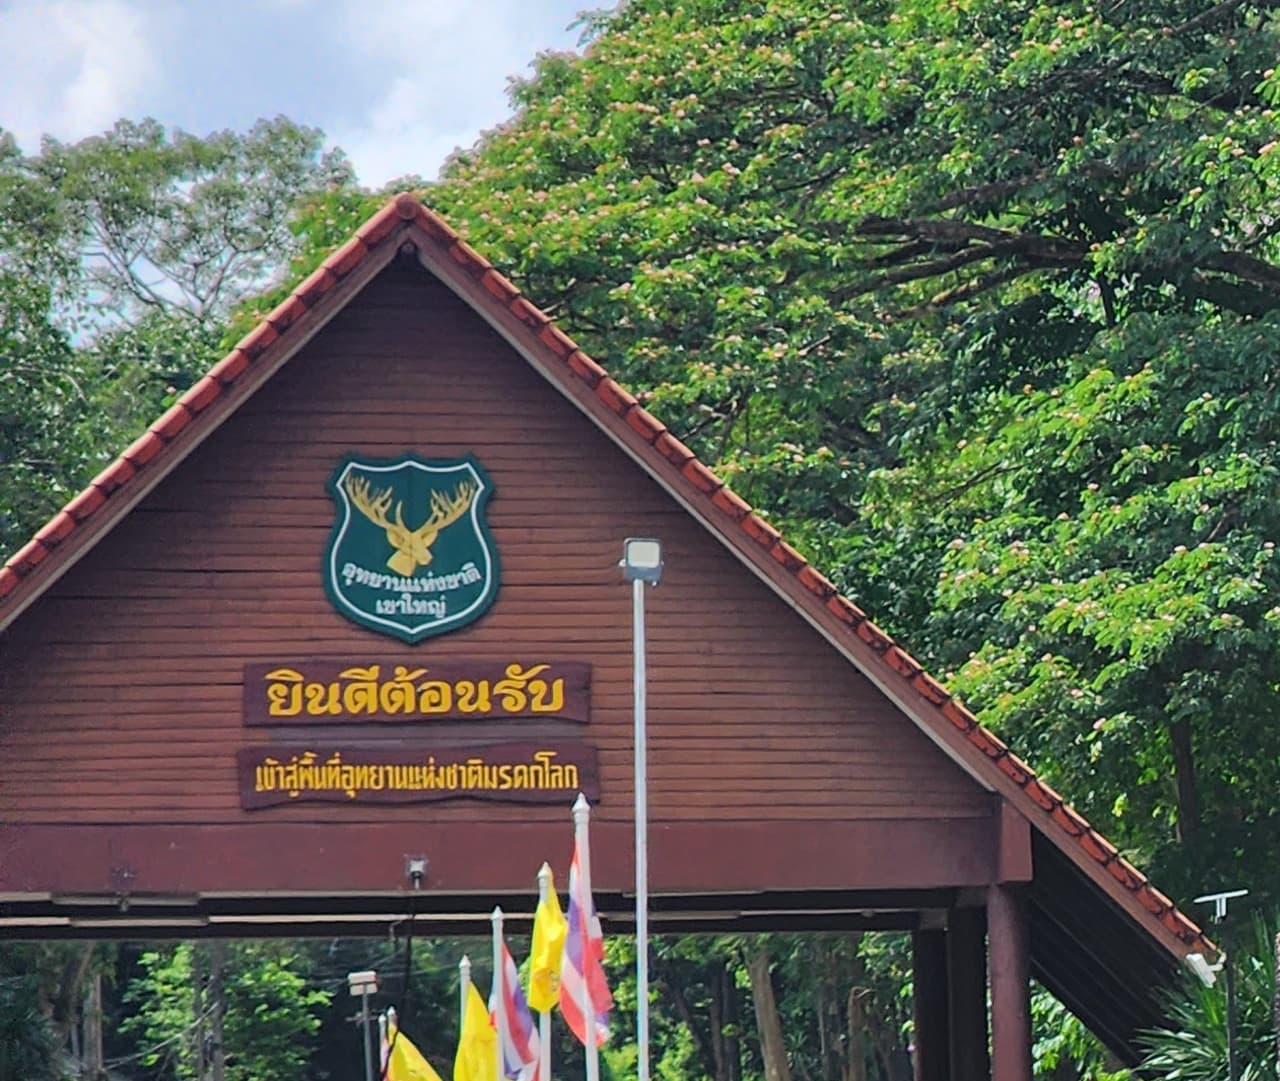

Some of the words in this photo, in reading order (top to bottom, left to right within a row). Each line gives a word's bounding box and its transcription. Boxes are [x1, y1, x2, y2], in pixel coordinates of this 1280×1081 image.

[342, 562, 482, 593] อุทยานแห่งชาติ
[376, 593, 446, 618] เขาใหญ่
[264, 664, 564, 716] ยินดีต้อนรับ
